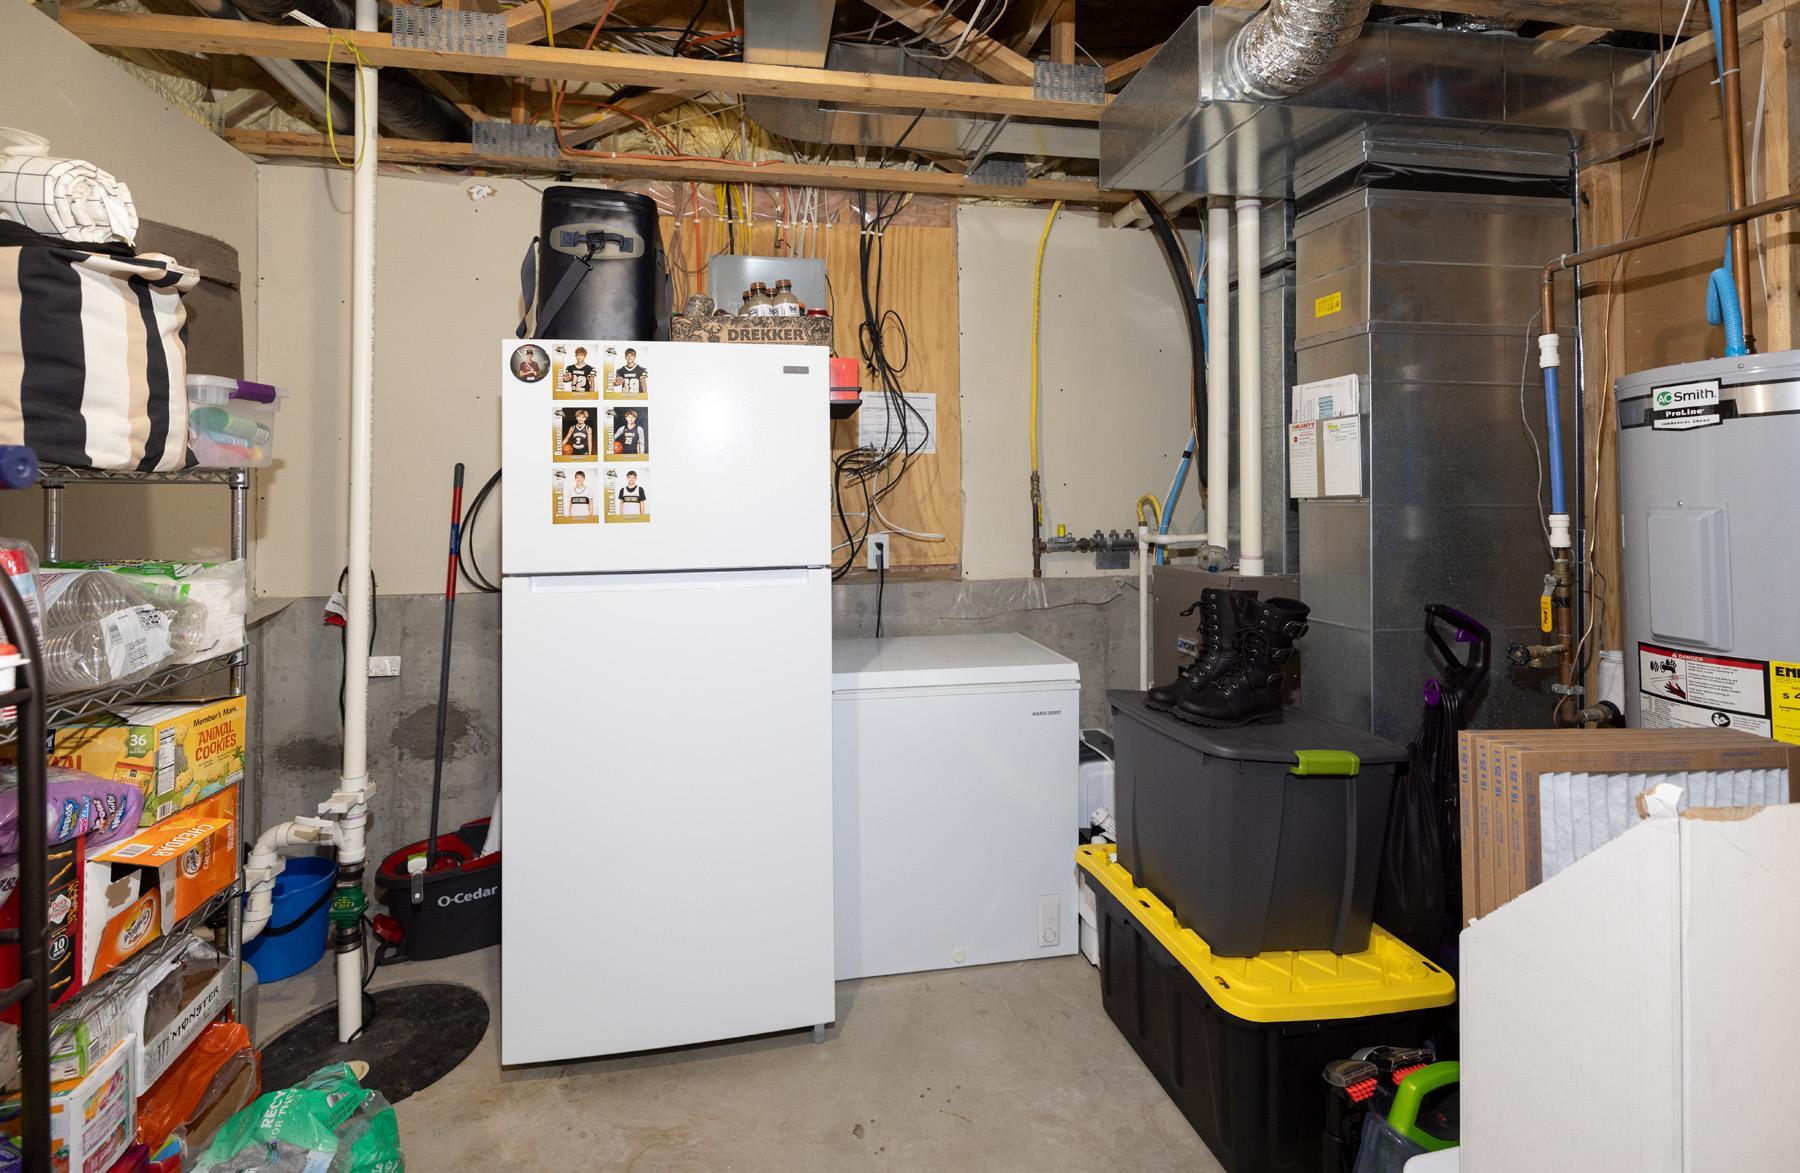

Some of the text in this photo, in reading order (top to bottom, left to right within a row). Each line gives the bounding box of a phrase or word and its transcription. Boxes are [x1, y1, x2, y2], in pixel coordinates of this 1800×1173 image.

[727, 328, 805, 341] DREKKER
[1673, 388, 1714, 402] Smith
[1665, 408, 1703, 418] ProLine
[1678, 653, 1704, 662] DANGER
[129, 734, 147, 747] 36
[198, 720, 234, 746] ANIMAL
[195, 733, 237, 761] COOKIES
[151, 823, 214, 857] CHEDDAR
[437, 885, 498, 907] O-Cedar
[54, 937, 65, 953] 10
[171, 985, 219, 1041] MONSTER
